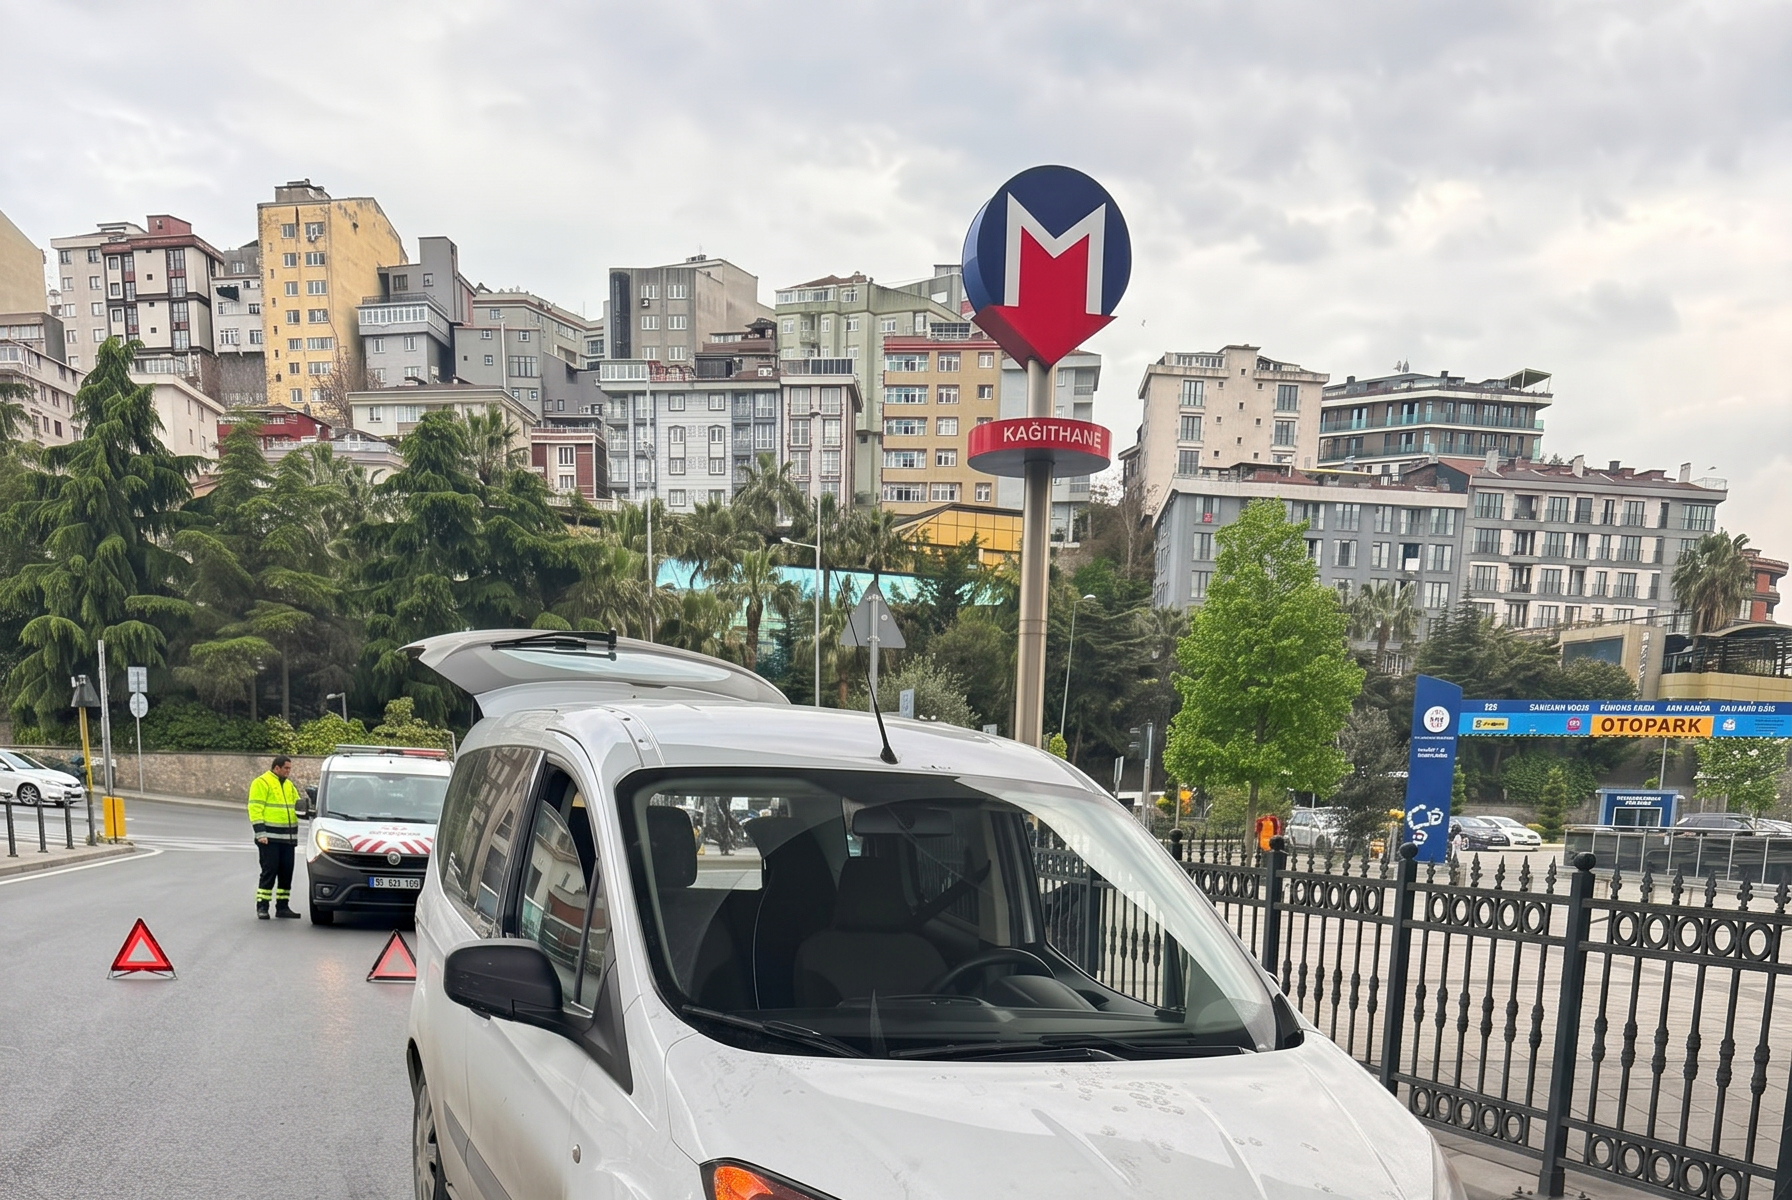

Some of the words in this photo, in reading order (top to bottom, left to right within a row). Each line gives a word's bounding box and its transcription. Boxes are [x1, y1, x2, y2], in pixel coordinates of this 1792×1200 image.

[1003, 192, 1107, 316] M
[1003, 421, 1102, 450] KAĞITHANE
[1600, 717, 1702, 734] OTOPARK
